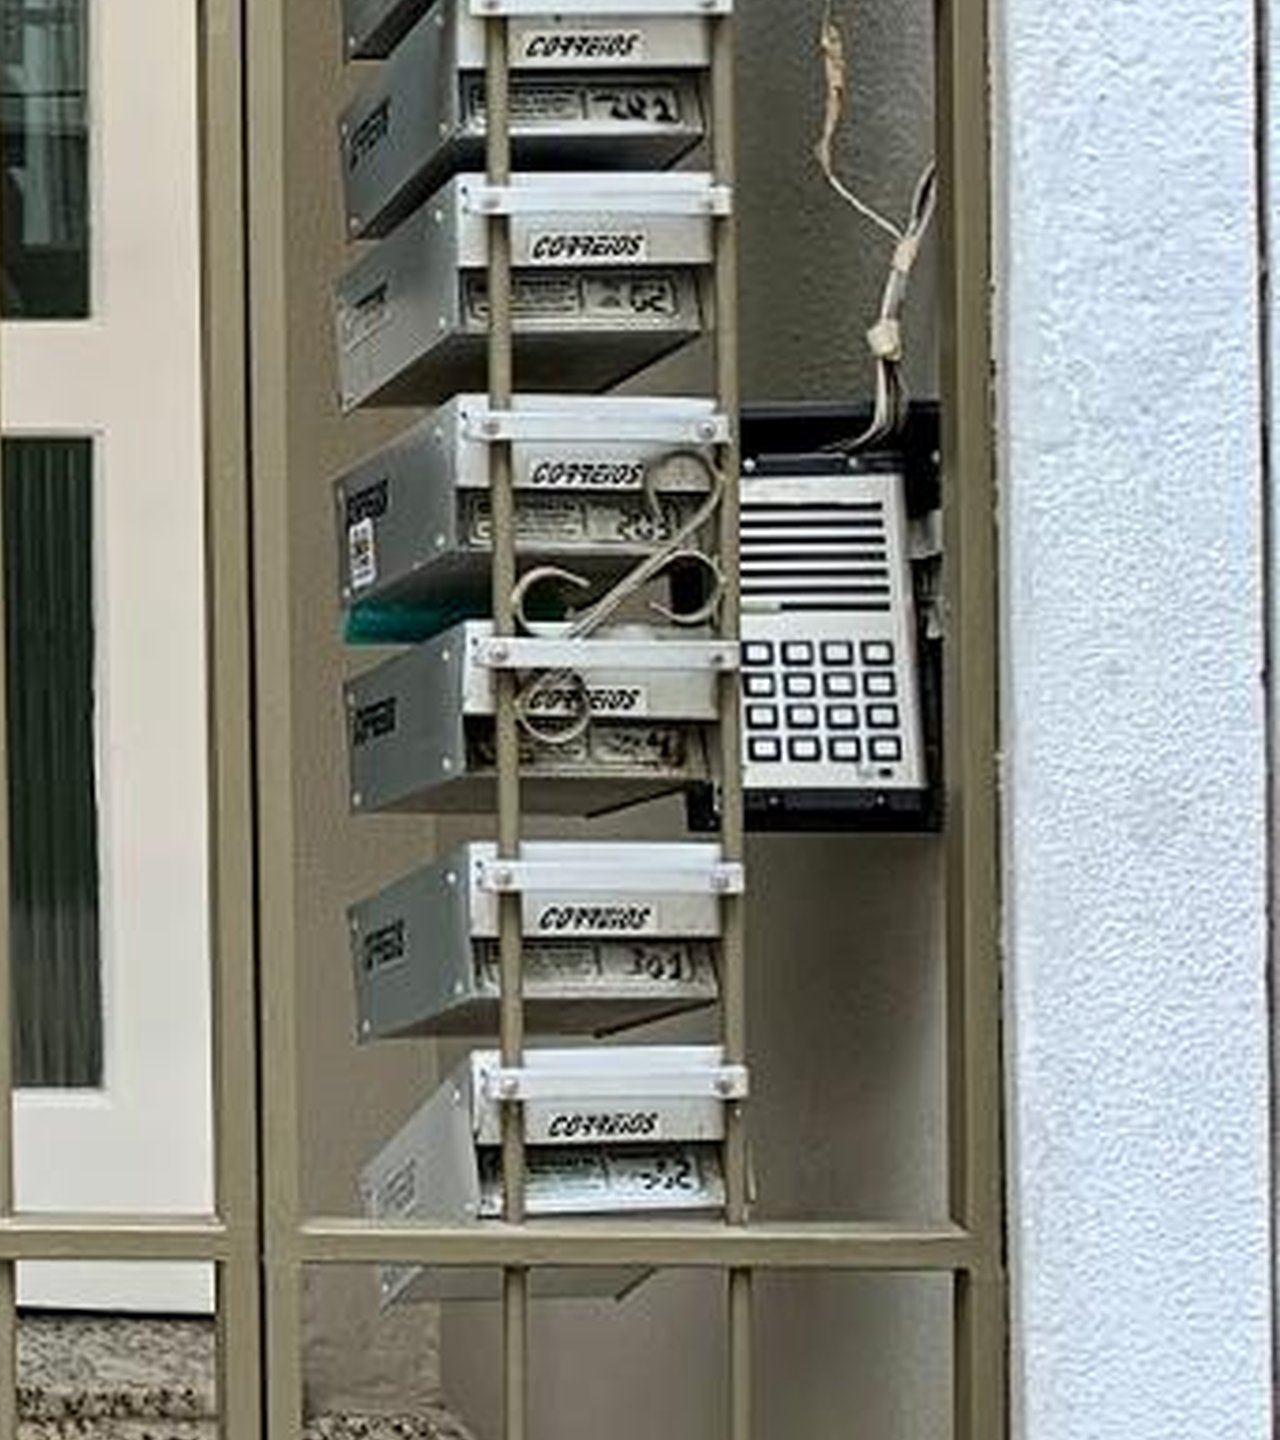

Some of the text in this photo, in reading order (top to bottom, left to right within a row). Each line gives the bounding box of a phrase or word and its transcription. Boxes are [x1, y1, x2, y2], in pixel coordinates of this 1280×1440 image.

[525, 33, 639, 57] CORREIOS
[532, 234, 645, 258] CORREIOS
[532, 461, 645, 485] CORREIOS
[539, 906, 652, 931] CORREIOS
[548, 1112, 659, 1137] CORREIOS
